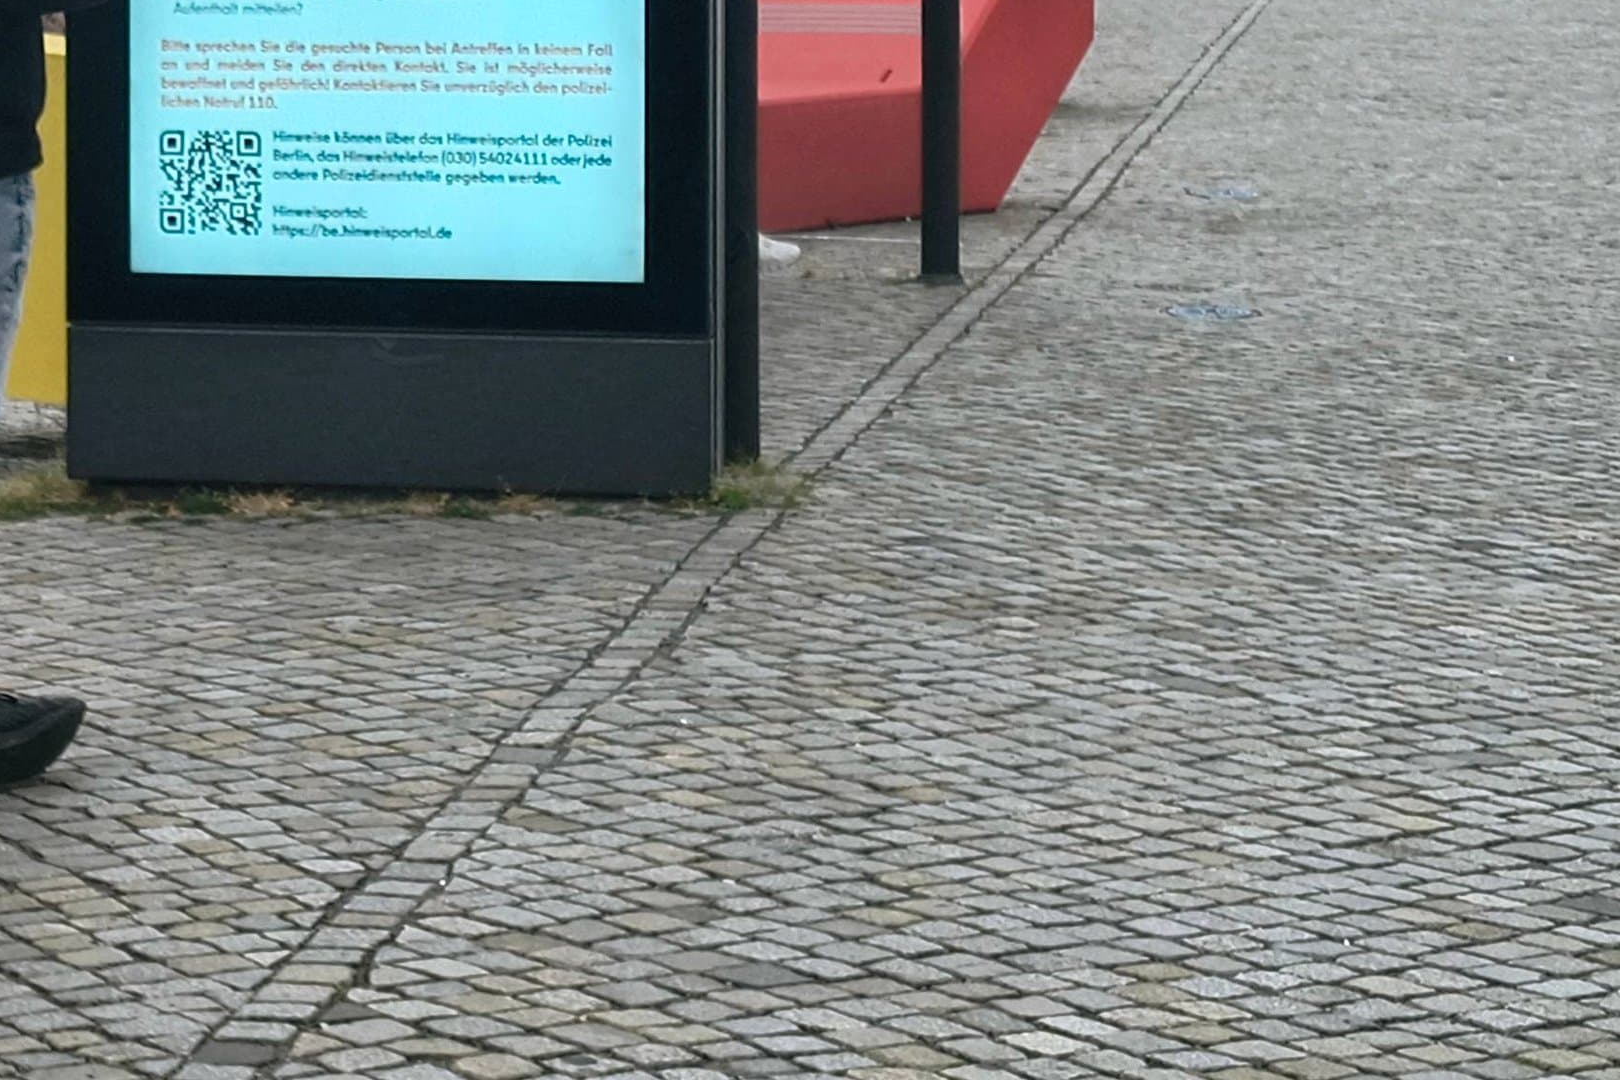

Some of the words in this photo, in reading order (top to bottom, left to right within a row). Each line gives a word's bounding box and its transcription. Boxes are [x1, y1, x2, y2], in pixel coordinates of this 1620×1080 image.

[271, 130, 330, 142] Hinweise
[333, 131, 382, 143] können
[385, 132, 415, 144] über
[418, 132, 443, 144] das
[542, 133, 564, 146] der
[567, 134, 612, 147] Polizei
[271, 149, 314, 162] Berlin,
[316, 149, 340, 162] das
[441, 150, 477, 166] (030)
[550, 152, 581, 165] oder
[582, 153, 612, 169] jede
[271, 168, 318, 180] andere
[445, 170, 504, 185] gegeben
[508, 171, 561, 184] werden.
